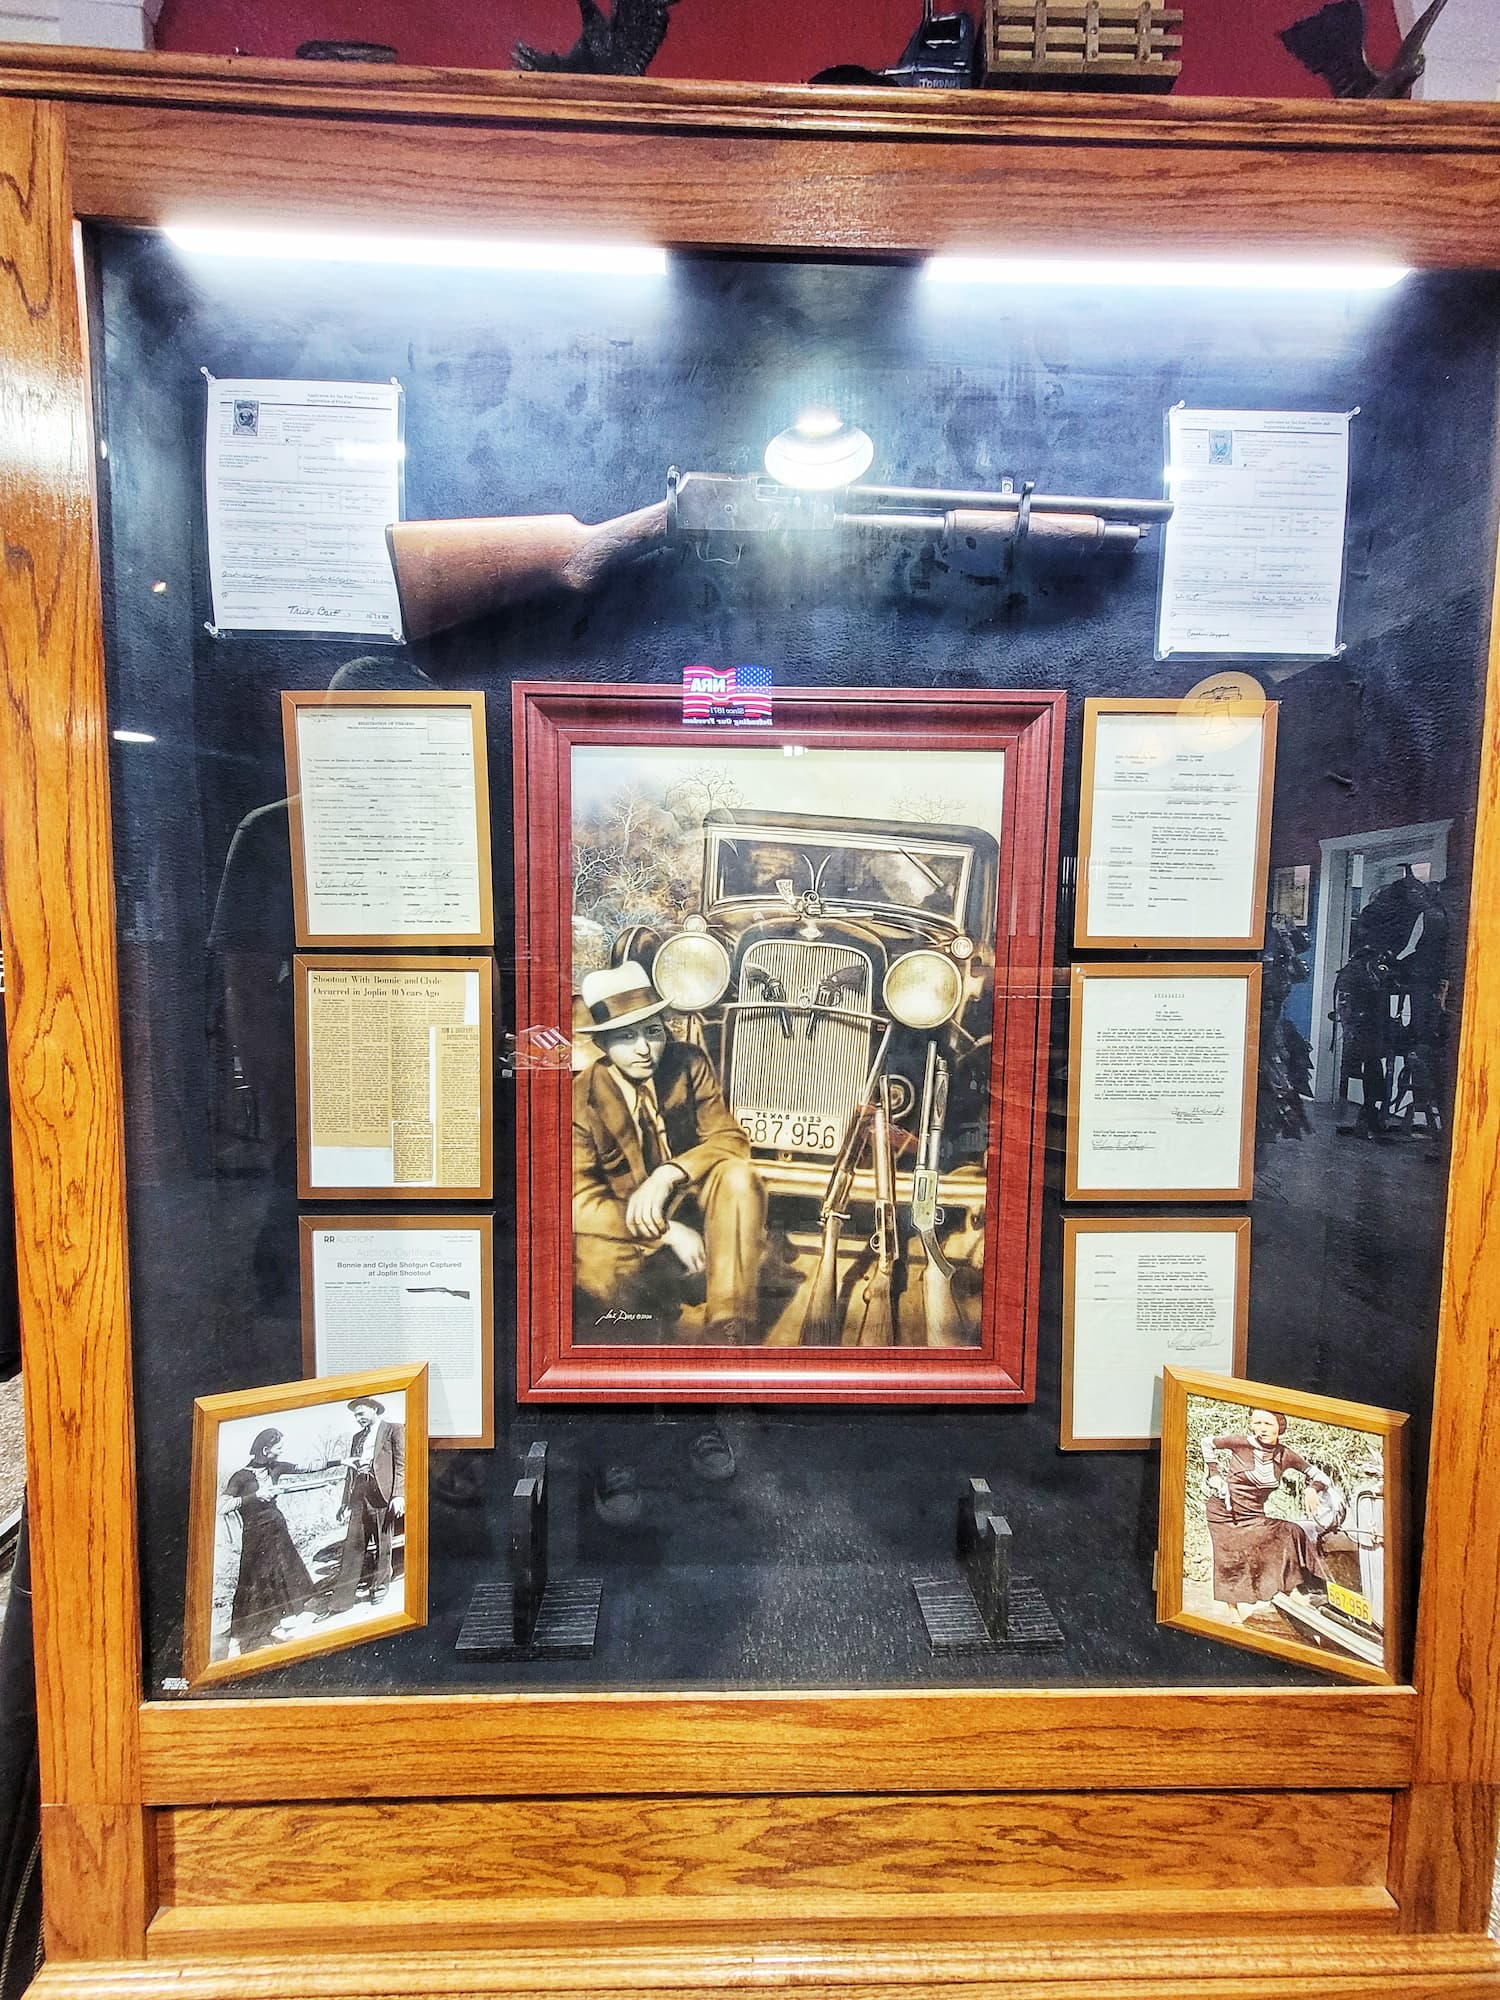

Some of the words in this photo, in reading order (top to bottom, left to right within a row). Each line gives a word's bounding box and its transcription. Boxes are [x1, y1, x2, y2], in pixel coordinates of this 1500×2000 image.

[313, 975, 347, 984] Shootout
[351, 975, 370, 984] With
[373, 975, 401, 984] Bonnie
[404, 976, 419, 984] and
[420, 976, 442, 987] Clyde
[313, 987, 350, 996] Occurred
[353, 987, 360, 995] in
[363, 988, 387, 998] Joplin
[400, 988, 423, 997] Years
[425, 989, 440, 998] Ago
[755, 1111, 790, 1120] TEXAS
[323, 1235, 335, 1244] RR
[337, 1261, 362, 1269] Bonnie
[363, 1261, 377, 1269] and
[377, 1261, 398, 1270] Clyde
[399, 1261, 429, 1270] Shotgun
[430, 1261, 462, 1270] Captured
[376, 1270, 398, 1279] Joplin
